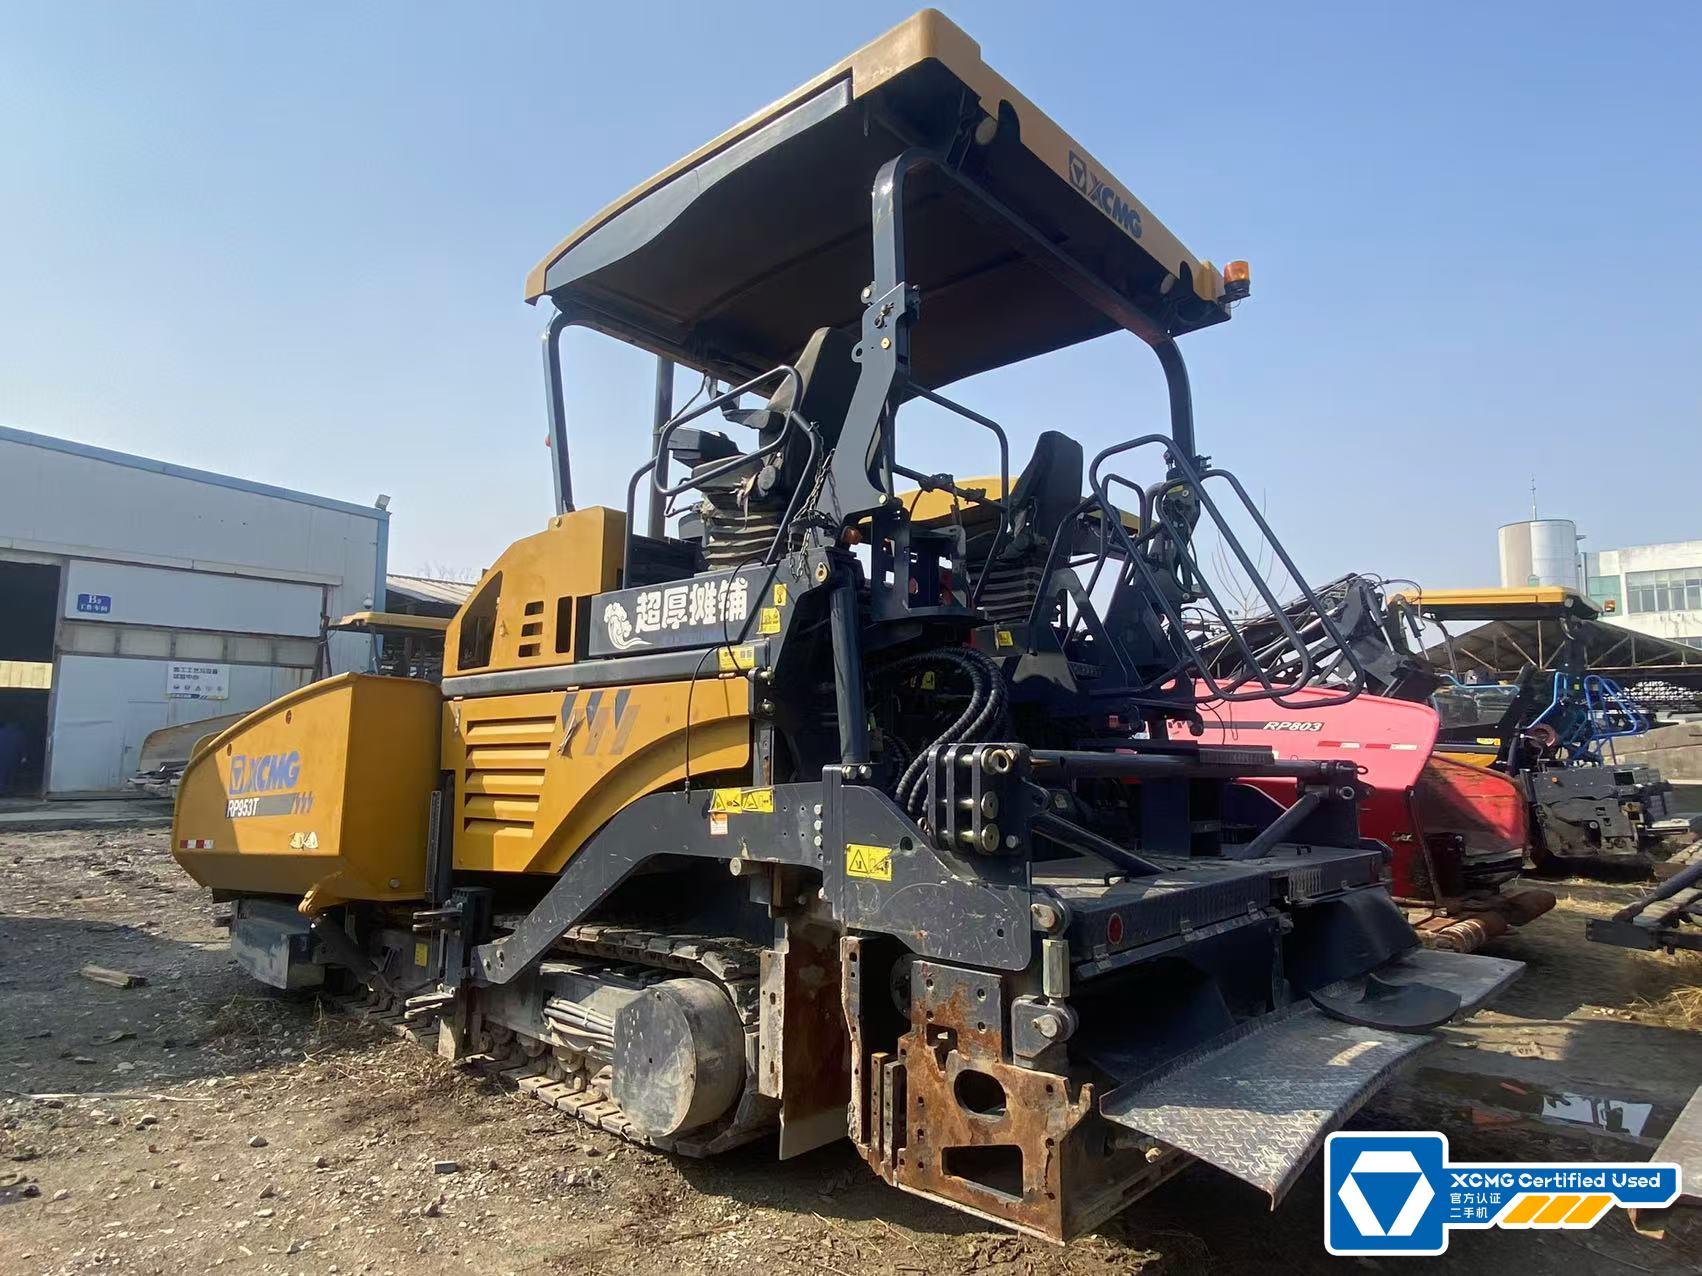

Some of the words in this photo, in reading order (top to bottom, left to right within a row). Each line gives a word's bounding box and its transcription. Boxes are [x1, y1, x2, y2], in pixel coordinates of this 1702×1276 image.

[1087, 172, 1143, 239] XCMG
[635, 577, 749, 634] 超厚摊铺
[1263, 721, 1323, 732] RP803
[241, 750, 301, 793] XCMG
[227, 797, 260, 818] RP953T
